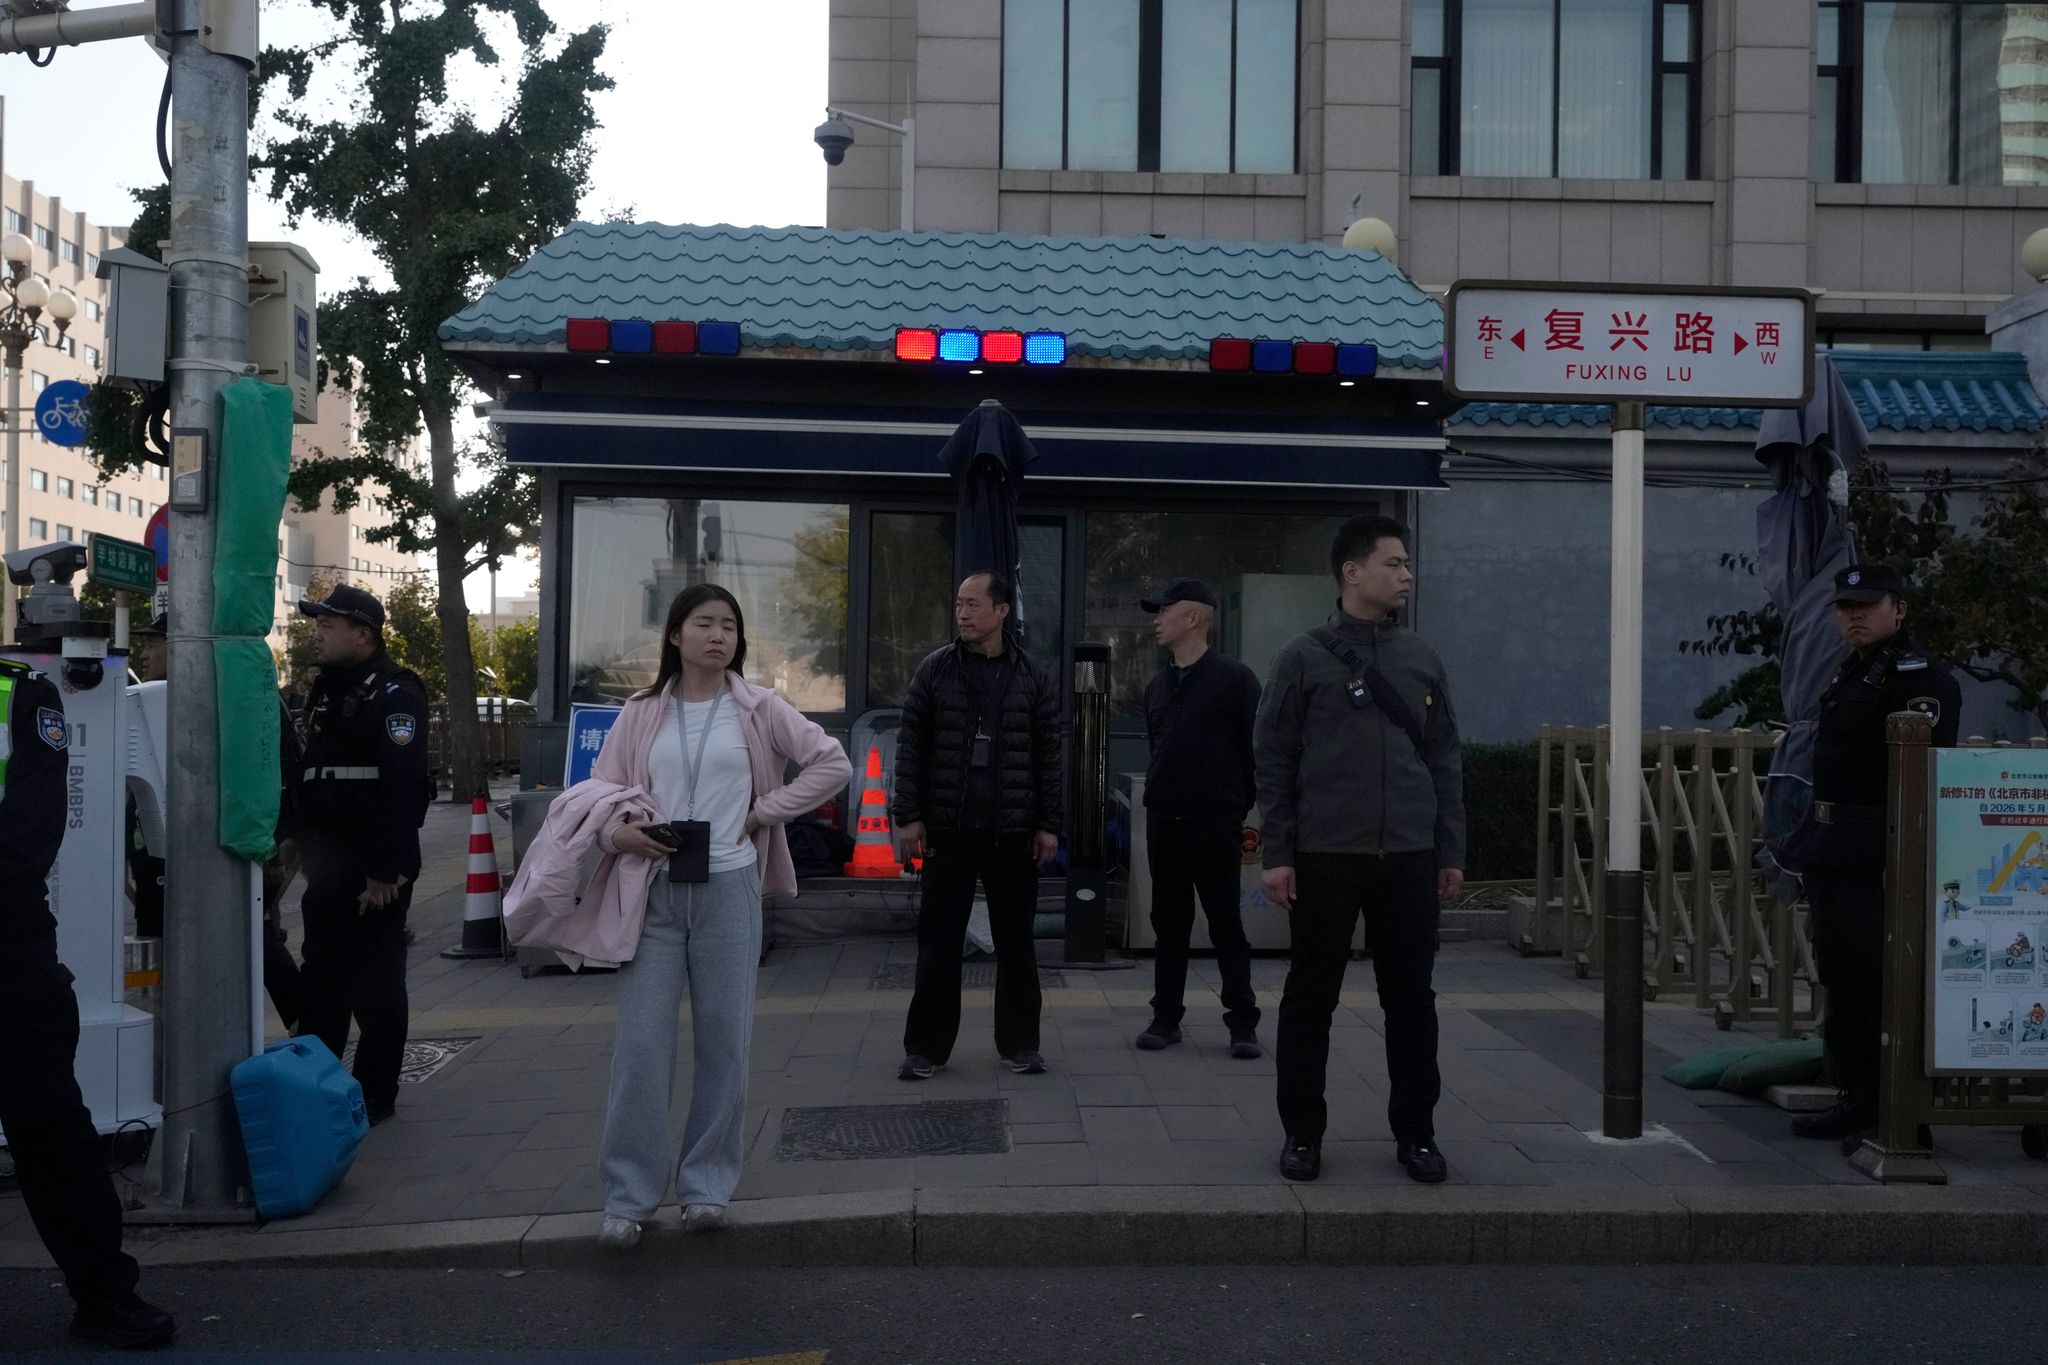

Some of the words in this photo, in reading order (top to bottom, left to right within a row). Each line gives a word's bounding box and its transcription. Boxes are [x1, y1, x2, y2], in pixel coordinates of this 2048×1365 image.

[1477, 315, 1502, 343] 东
[1544, 308, 1714, 354] 复兴路
[1755, 321, 1780, 347] 西
[1484, 346, 1494, 360] E
[1761, 350, 1776, 366] W
[1566, 364, 1648, 381] FUXING
[1667, 366, 1692, 382] LU
[97, 543, 137, 573] 羊坊店路
[68, 765, 84, 829] BMBPS
